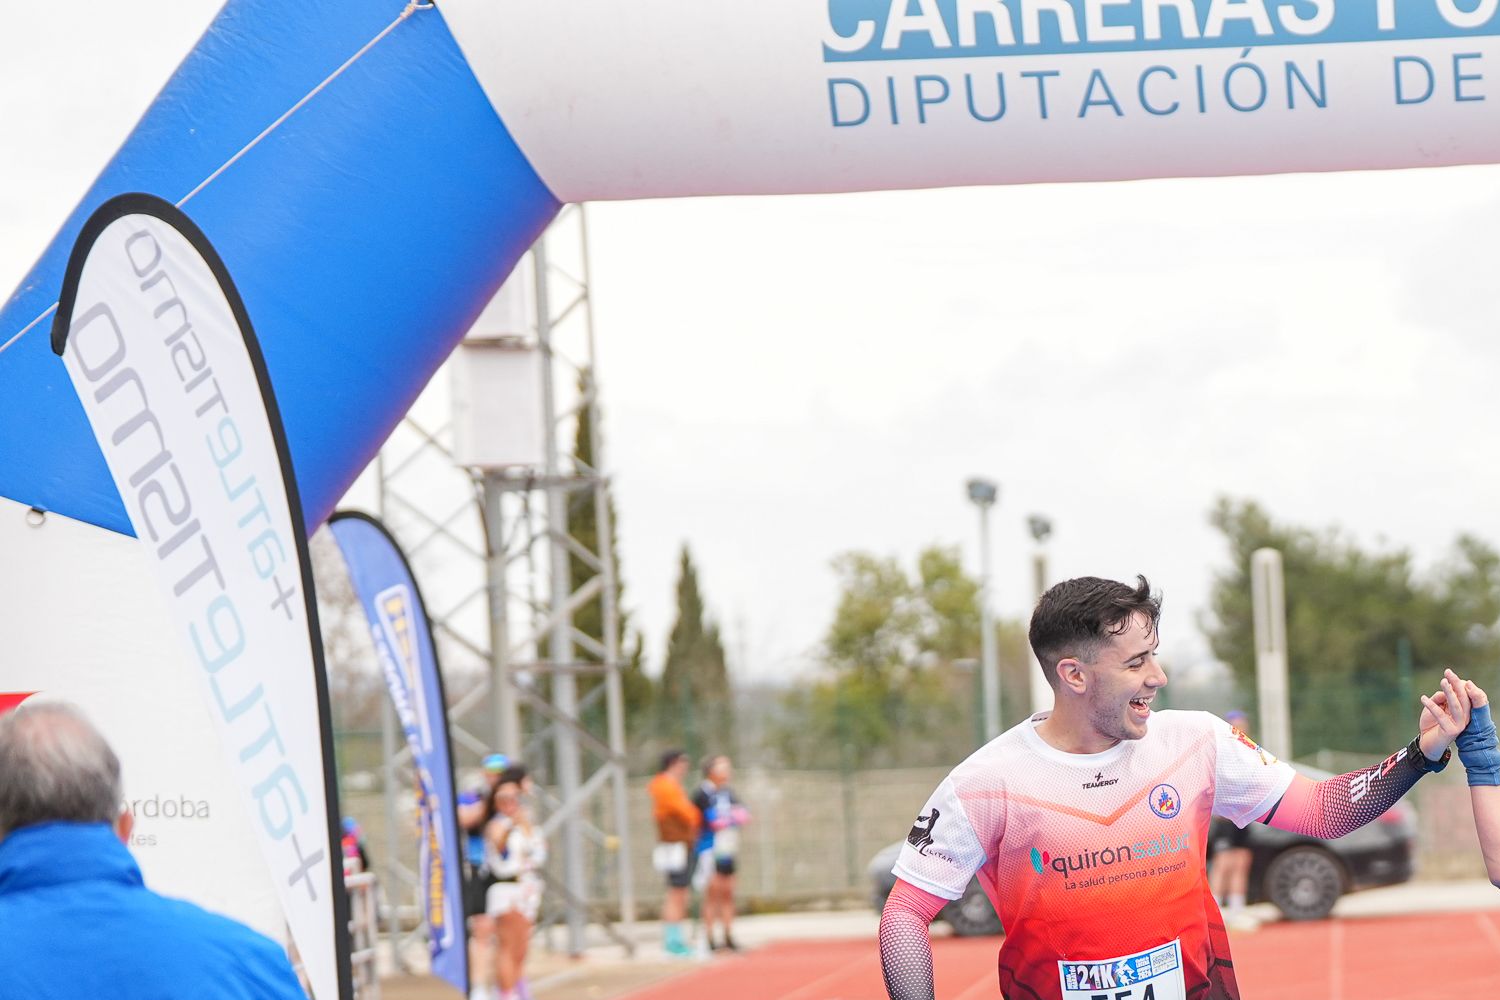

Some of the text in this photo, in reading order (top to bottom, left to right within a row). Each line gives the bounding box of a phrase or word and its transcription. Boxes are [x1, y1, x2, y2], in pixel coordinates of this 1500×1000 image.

[827, 47, 1328, 128] DIPUTACIÓN
[1393, 52, 1486, 105] DE
[1065, 881, 1077, 891] La
[1080, 877, 1105, 890] salud
[1108, 869, 1147, 885] persona
[1077, 963, 1117, 990] 21K
